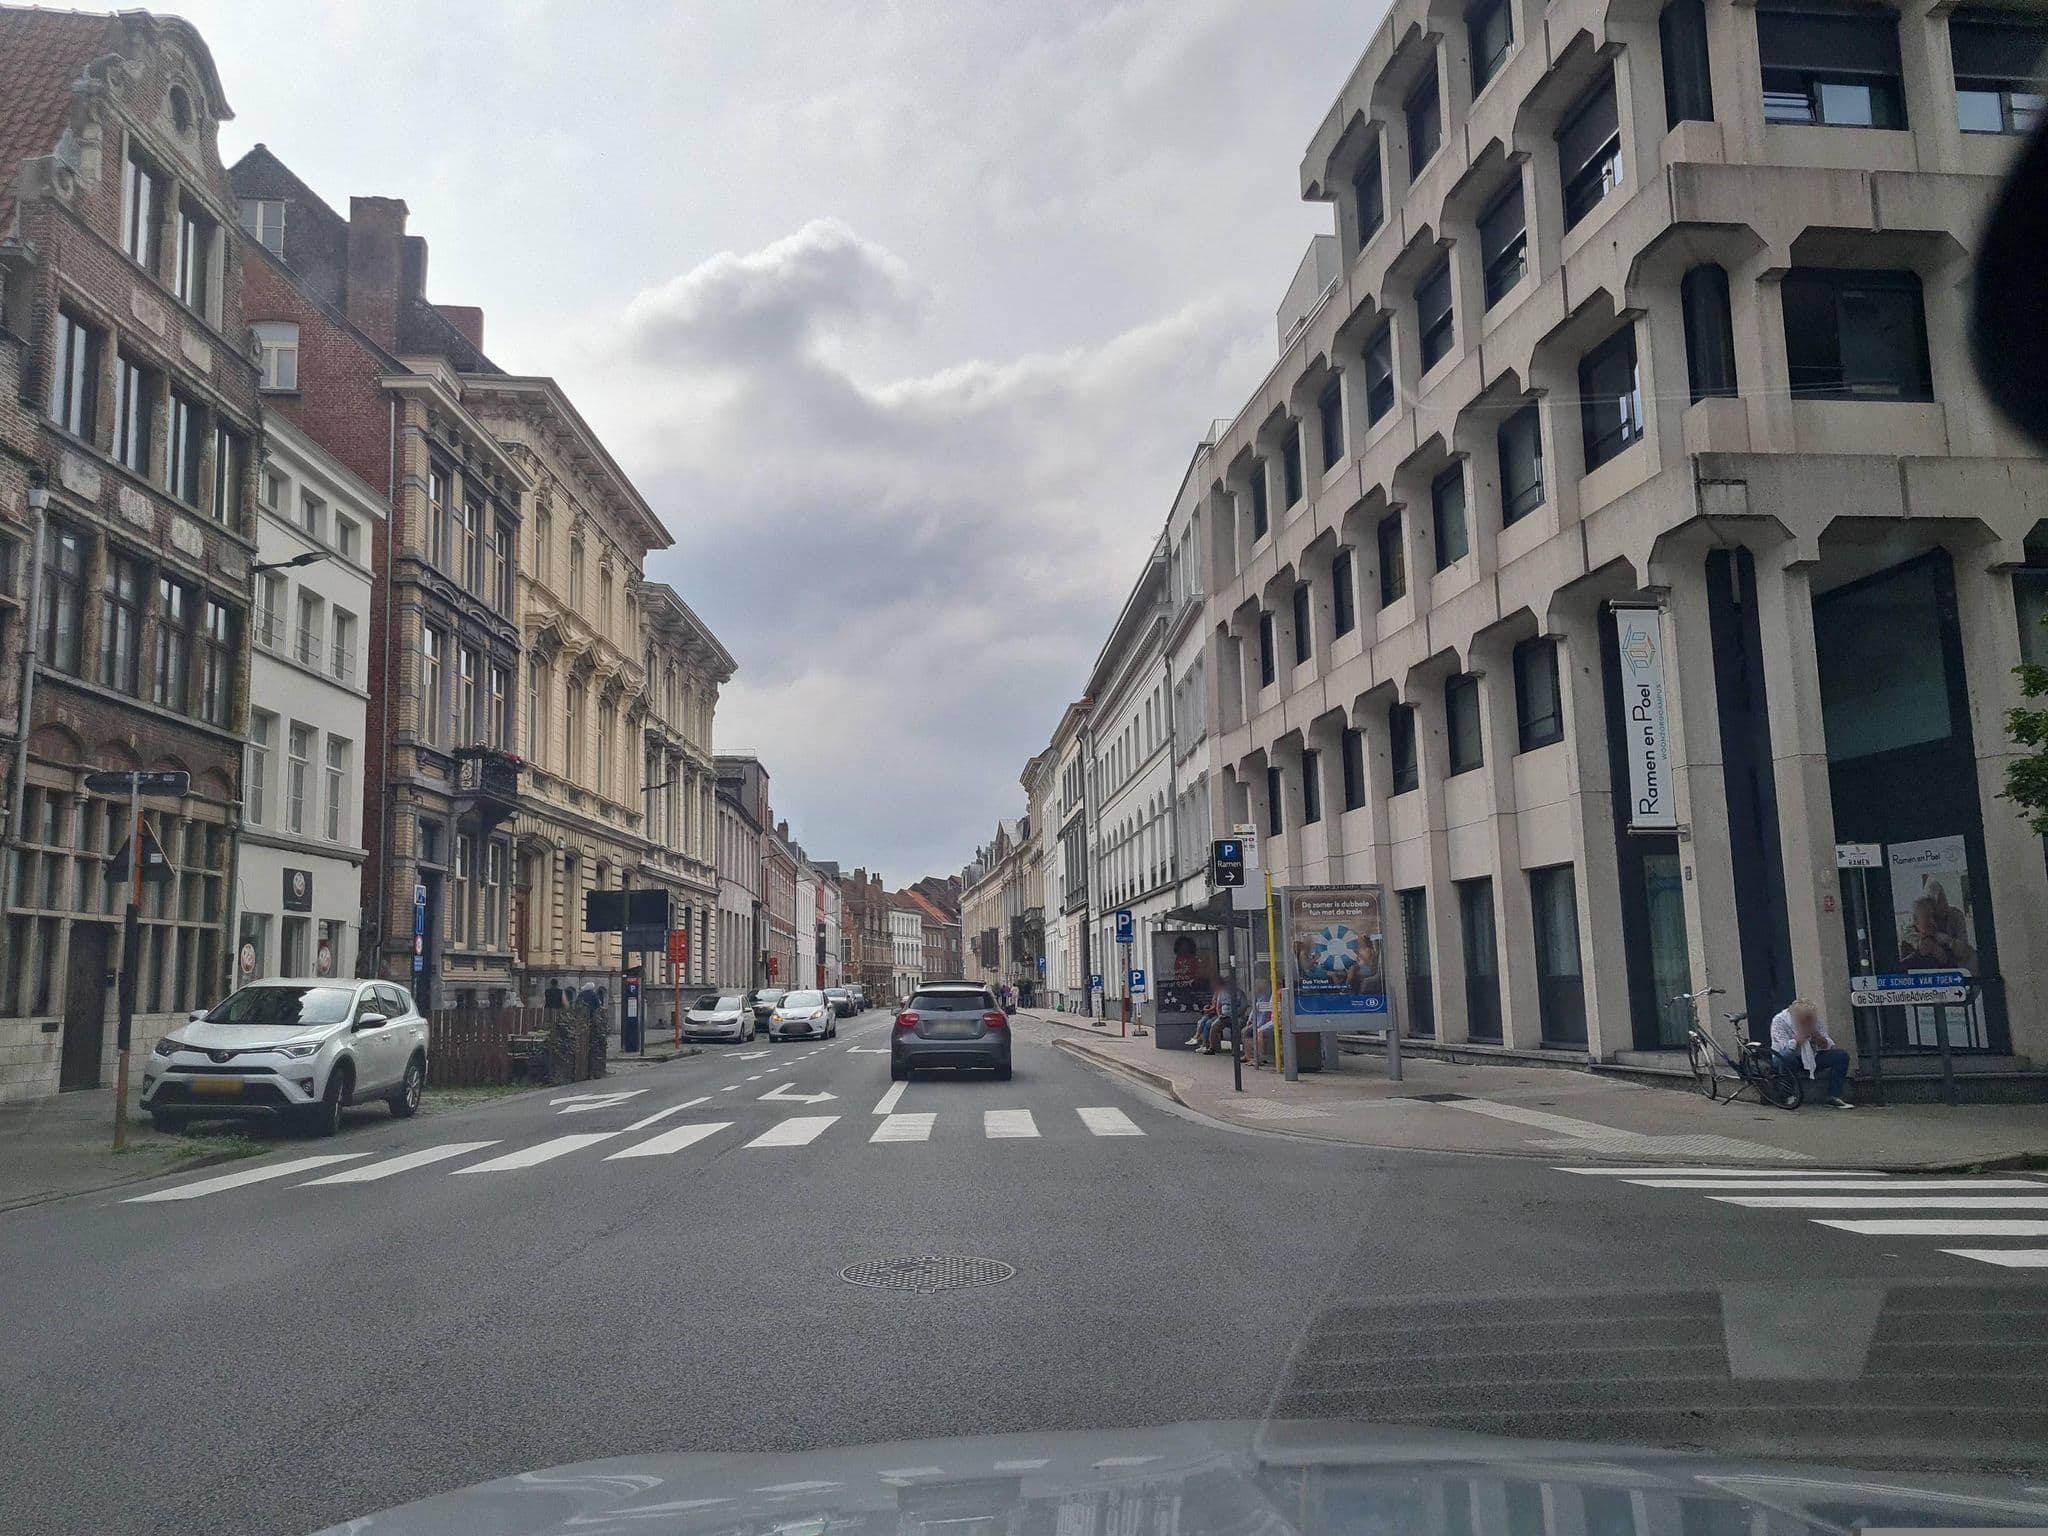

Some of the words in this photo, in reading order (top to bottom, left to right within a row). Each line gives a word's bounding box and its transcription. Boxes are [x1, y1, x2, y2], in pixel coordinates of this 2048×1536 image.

[1632, 684, 1652, 721] Poel
[1656, 684, 1668, 760] WOONZORGCAMPUS
[1643, 725, 1655, 747] en
[1639, 750, 1659, 814] Ramen
[1224, 844, 1234, 856] P
[1217, 860, 1242, 868] Ramen
[1848, 858, 1871, 866] RAMEN
[1892, 854, 1917, 865] Ramen
[1925, 850, 1940, 861] Poel
[1301, 901, 1312, 909] De
[1312, 901, 1334, 909] zomer
[1118, 913, 1130, 931] P
[1092, 976, 1099, 986] P
[1132, 971, 1142, 985] P
[1878, 978, 1885, 987] DE
[1890, 976, 1915, 986] SCHOOL
[1919, 975, 1934, 985] VAN
[1936, 974, 1953, 984] TOEN
[630, 985, 636, 993] P
[1857, 994, 1867, 1005] de
